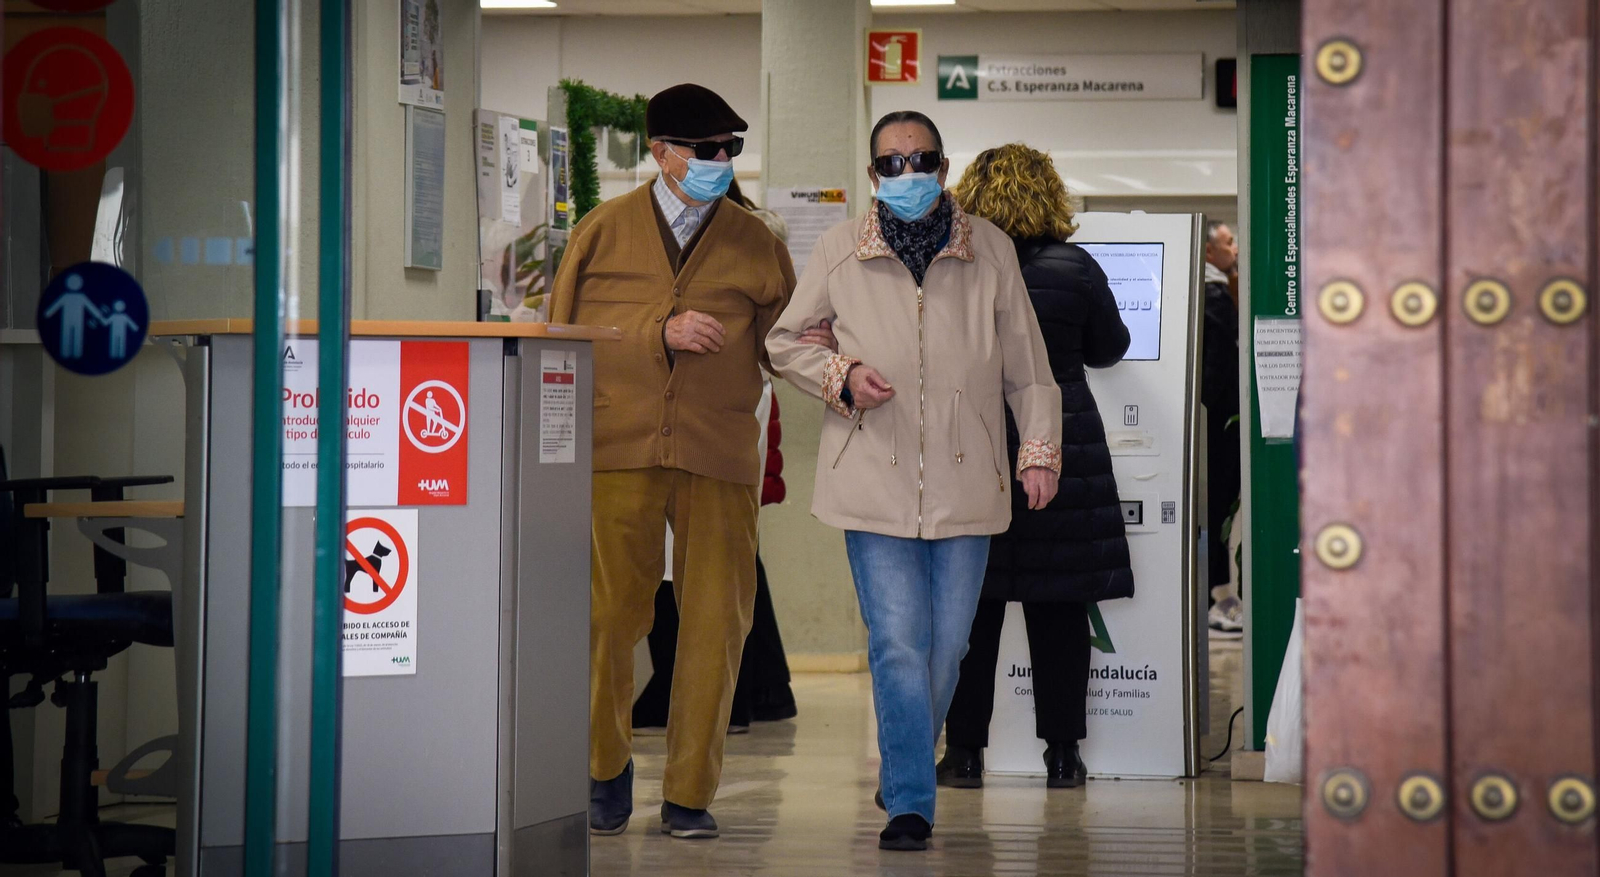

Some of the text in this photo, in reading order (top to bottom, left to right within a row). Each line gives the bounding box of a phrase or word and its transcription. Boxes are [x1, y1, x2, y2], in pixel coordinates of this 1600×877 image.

[988, 81, 1144, 93] C.S. Esperanza Macarena
[1284, 75, 1296, 128] Macarena
[1285, 130, 1298, 184] Esperanza
[1286, 264, 1296, 278] de
[1284, 280, 1296, 316] Centro
[281, 387, 381, 409] Proido
[286, 428, 308, 441] tipo
[310, 428, 319, 440] d
[302, 460, 310, 470] el
[345, 460, 385, 471] ospitalario
[362, 622, 371, 630] EL
[372, 621, 400, 630] ACCESO
[400, 620, 411, 629] DE
[360, 632, 371, 640] DE
[371, 629, 408, 640] COMPAÑÍA
[1088, 664, 1158, 681] ndalucía
[1104, 690, 1111, 700] y
[1112, 688, 1151, 699] Familias
[1099, 708, 1109, 716] DE
[1110, 708, 1134, 717] SALUD
